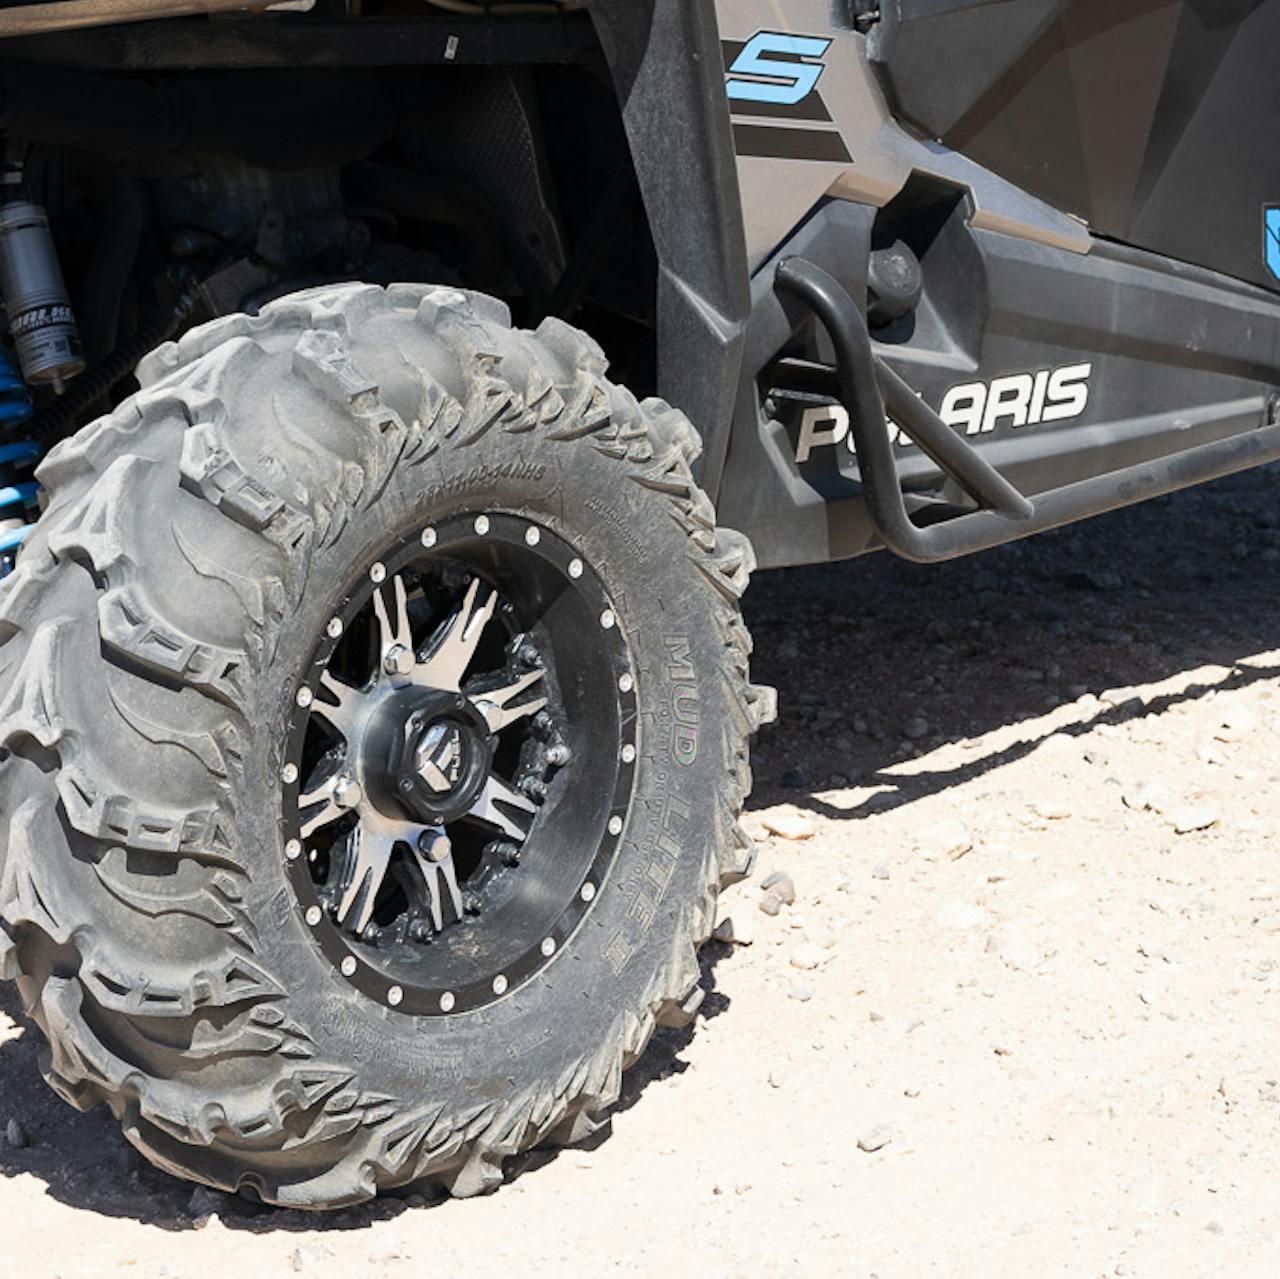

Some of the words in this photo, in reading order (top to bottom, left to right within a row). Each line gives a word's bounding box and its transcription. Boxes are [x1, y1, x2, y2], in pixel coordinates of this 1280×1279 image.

[724, 29, 835, 106] S
[795, 363, 1091, 463] PARIS
[664, 634, 701, 767] MUD
